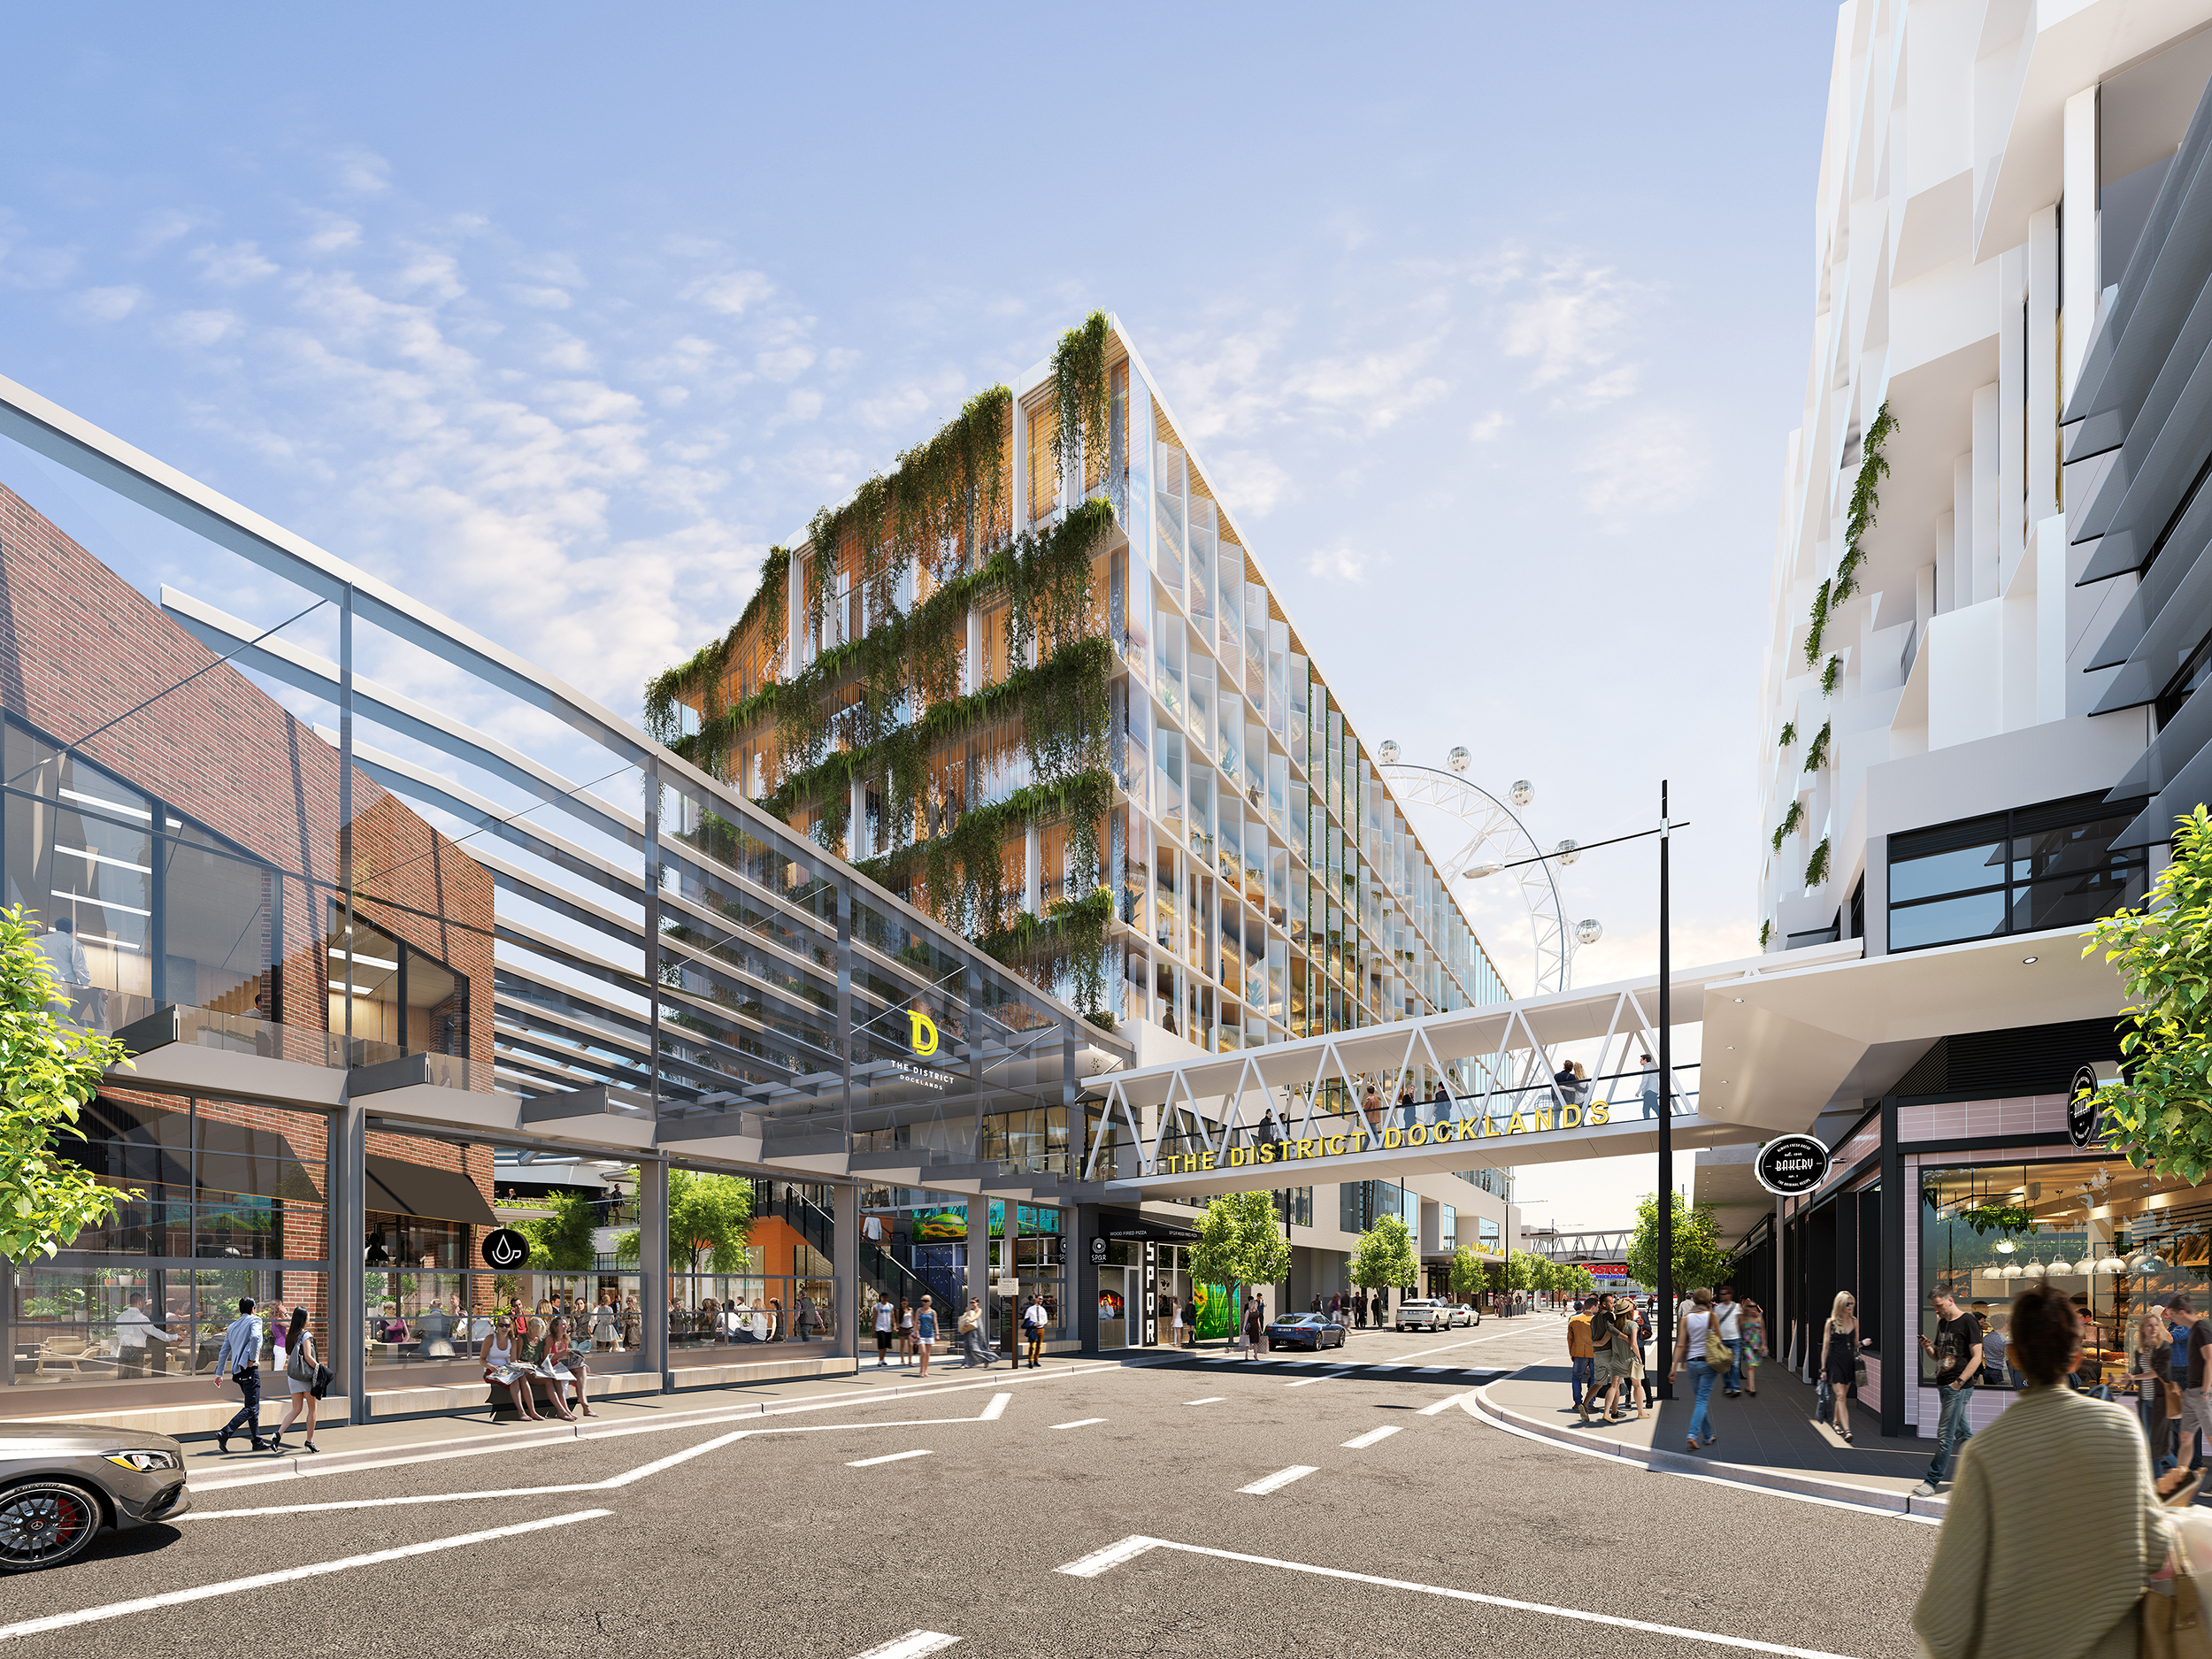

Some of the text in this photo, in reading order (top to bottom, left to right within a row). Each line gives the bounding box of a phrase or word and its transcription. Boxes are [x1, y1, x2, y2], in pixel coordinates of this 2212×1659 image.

[890, 1060, 955, 1084] THE DISTRICT
[900, 1074, 943, 1090] DOCKLANDS
[1168, 1101, 1609, 1174] THE DISTRICT DOCKLANDS
[1775, 1158, 1813, 1171] BAKERY
